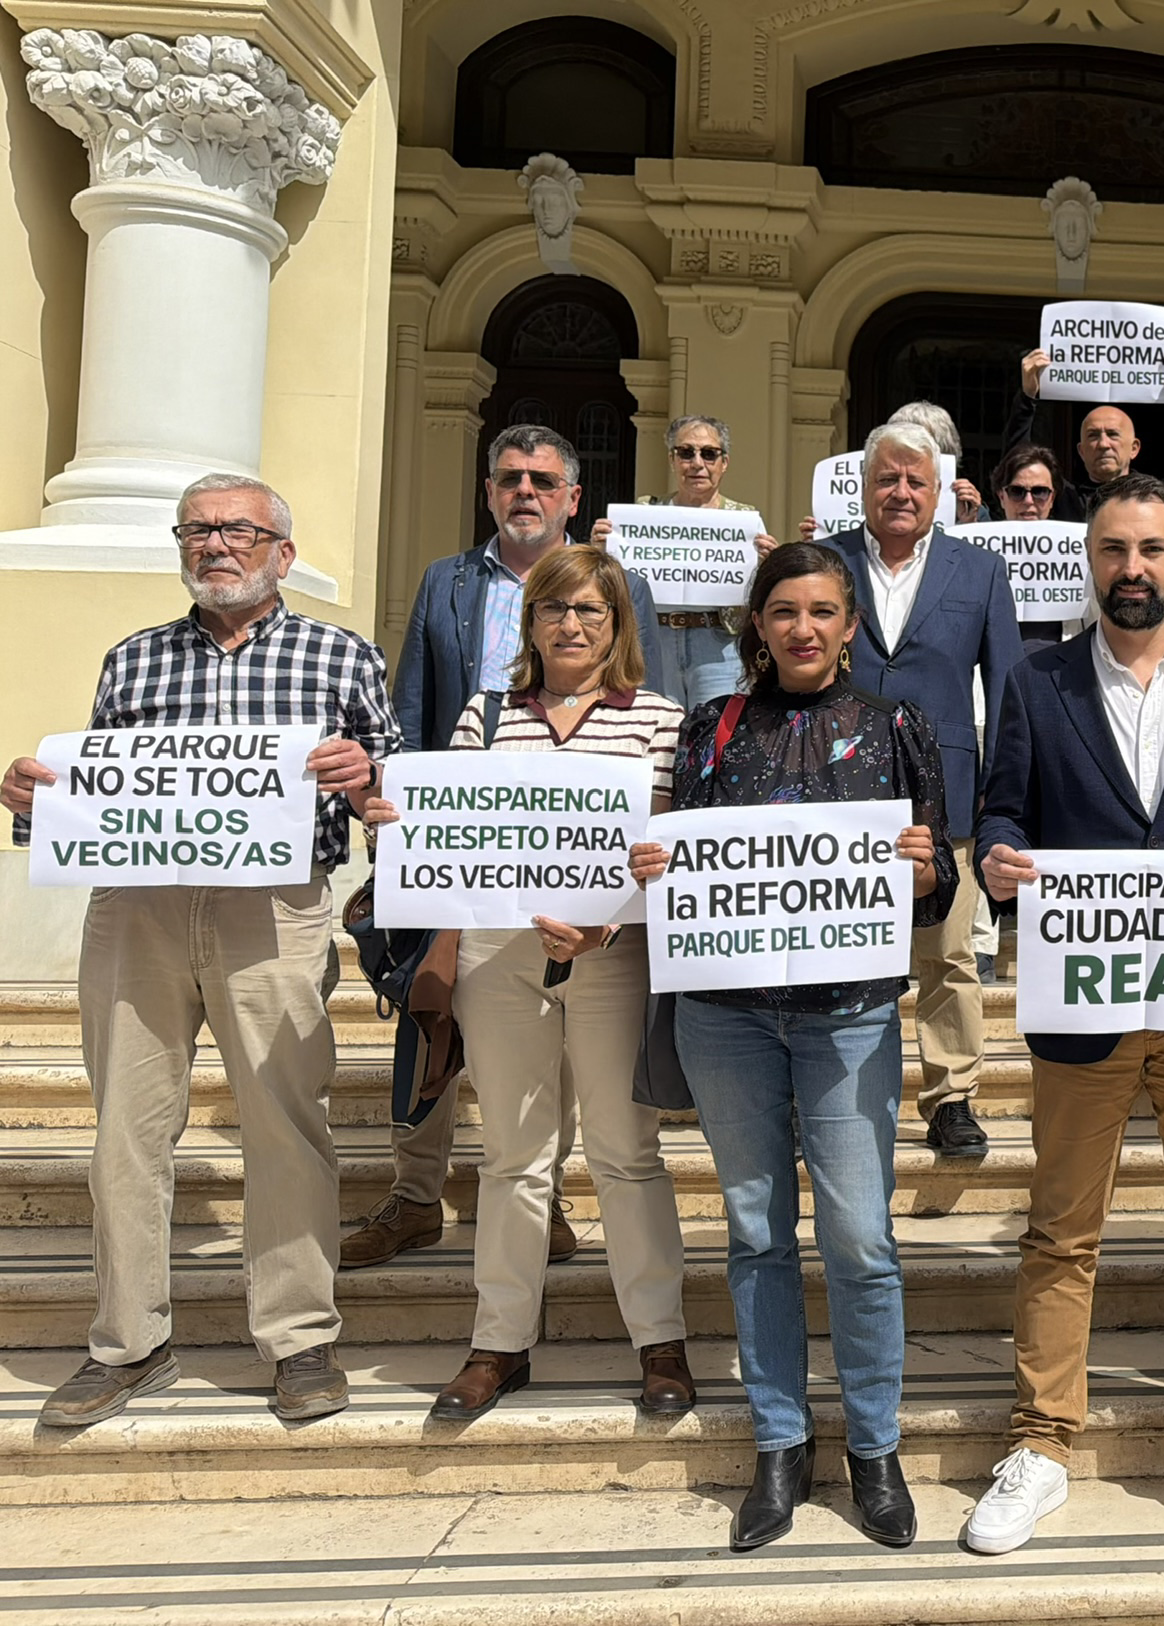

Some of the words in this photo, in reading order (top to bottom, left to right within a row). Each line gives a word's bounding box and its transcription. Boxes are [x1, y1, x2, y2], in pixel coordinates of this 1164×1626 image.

[1051, 319, 1138, 339] ARCHIVO
[1143, 322, 1164, 340] de
[1050, 344, 1065, 362] la
[1049, 369, 1099, 384] PARQUE
[1102, 371, 1124, 384] DEL
[835, 461, 854, 475] EL
[831, 479, 858, 495] NO
[619, 524, 746, 542] TRANSPARENCIA
[619, 545, 629, 559] Y
[633, 546, 701, 561] RESPETO
[705, 549, 745, 563] PARA
[1058, 536, 1082, 555] de
[652, 568, 744, 584] VECINOS/AS
[1008, 562, 1083, 581] FORMA
[1015, 588, 1039, 602] DEL
[1042, 588, 1083, 602] OESTE
[80, 736, 120, 758] EL
[130, 735, 280, 760] PARQUE
[71, 766, 124, 796] NO
[132, 767, 177, 796] SE
[186, 767, 284, 797] TOCA
[403, 787, 629, 812] TRANSPARENCIA
[100, 808, 162, 834] SIN
[176, 809, 249, 835] LOS
[401, 825, 420, 849] Y
[426, 825, 549, 850] RESPETO
[556, 827, 627, 851] PARA
[52, 840, 292, 869] VECINOS/AS
[667, 833, 839, 873] ARCHIVO
[848, 832, 892, 864] de
[401, 864, 453, 889] LOS
[460, 865, 624, 889] VECINOS/AS
[668, 887, 697, 920] la
[709, 876, 895, 918] REFORMA
[668, 929, 765, 958] PARQUE
[771, 926, 815, 951] DEL
[820, 921, 894, 949] OESTE
